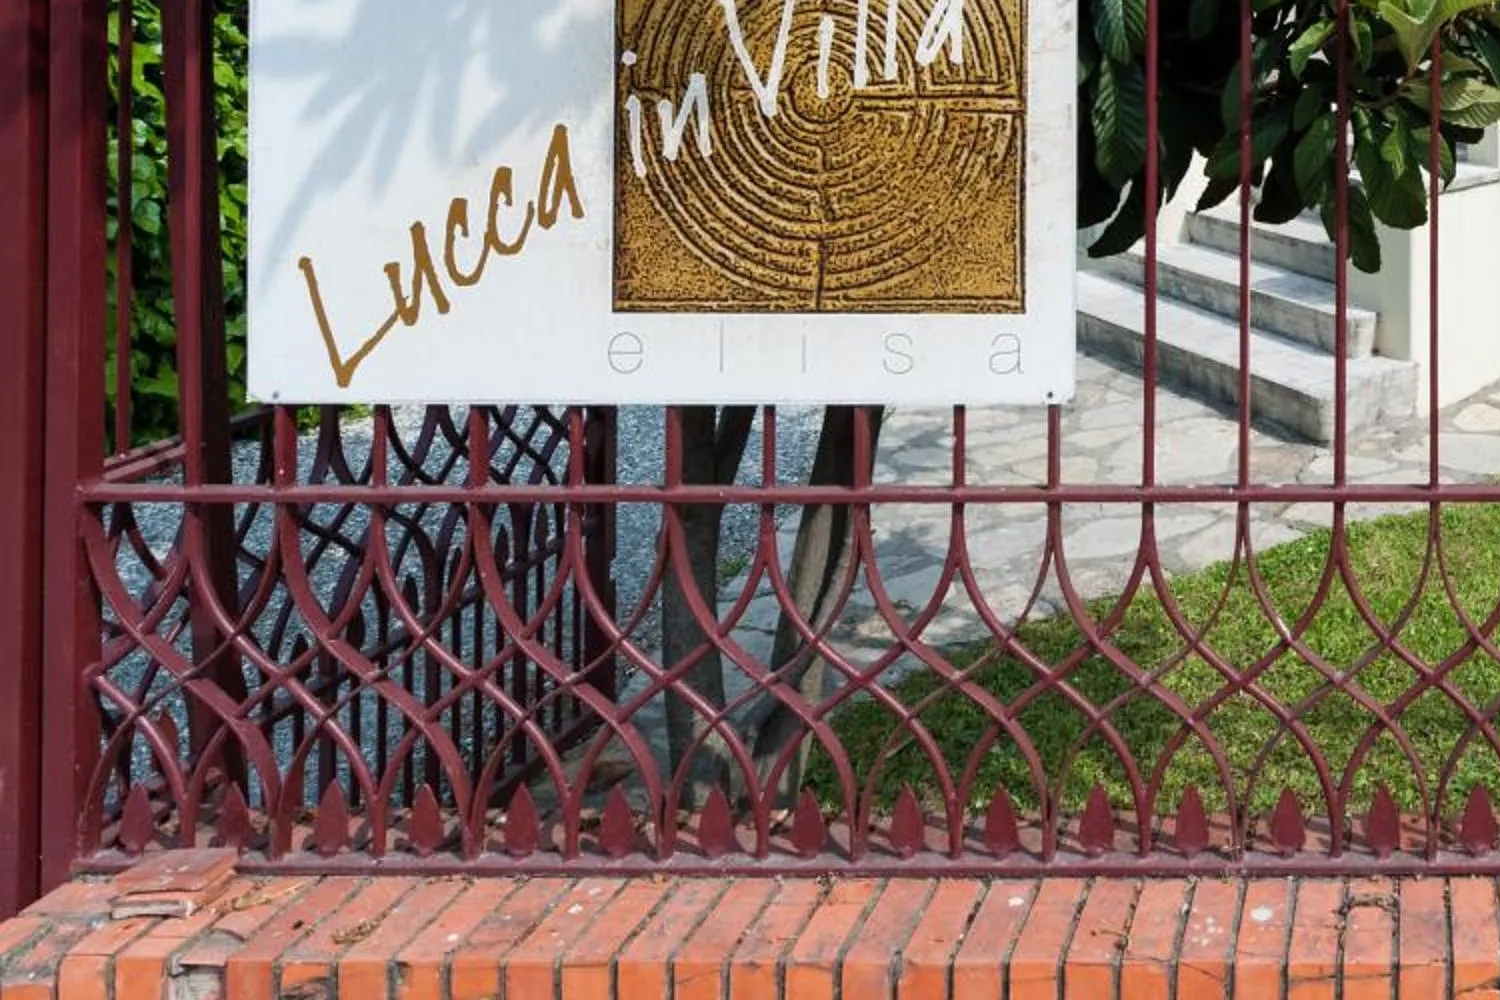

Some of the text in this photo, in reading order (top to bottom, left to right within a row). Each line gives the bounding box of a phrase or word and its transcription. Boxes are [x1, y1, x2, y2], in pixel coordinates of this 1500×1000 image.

[298, 124, 584, 388] Lucca
[621, 50, 713, 178] in
[607, 320, 1025, 375] elisa
